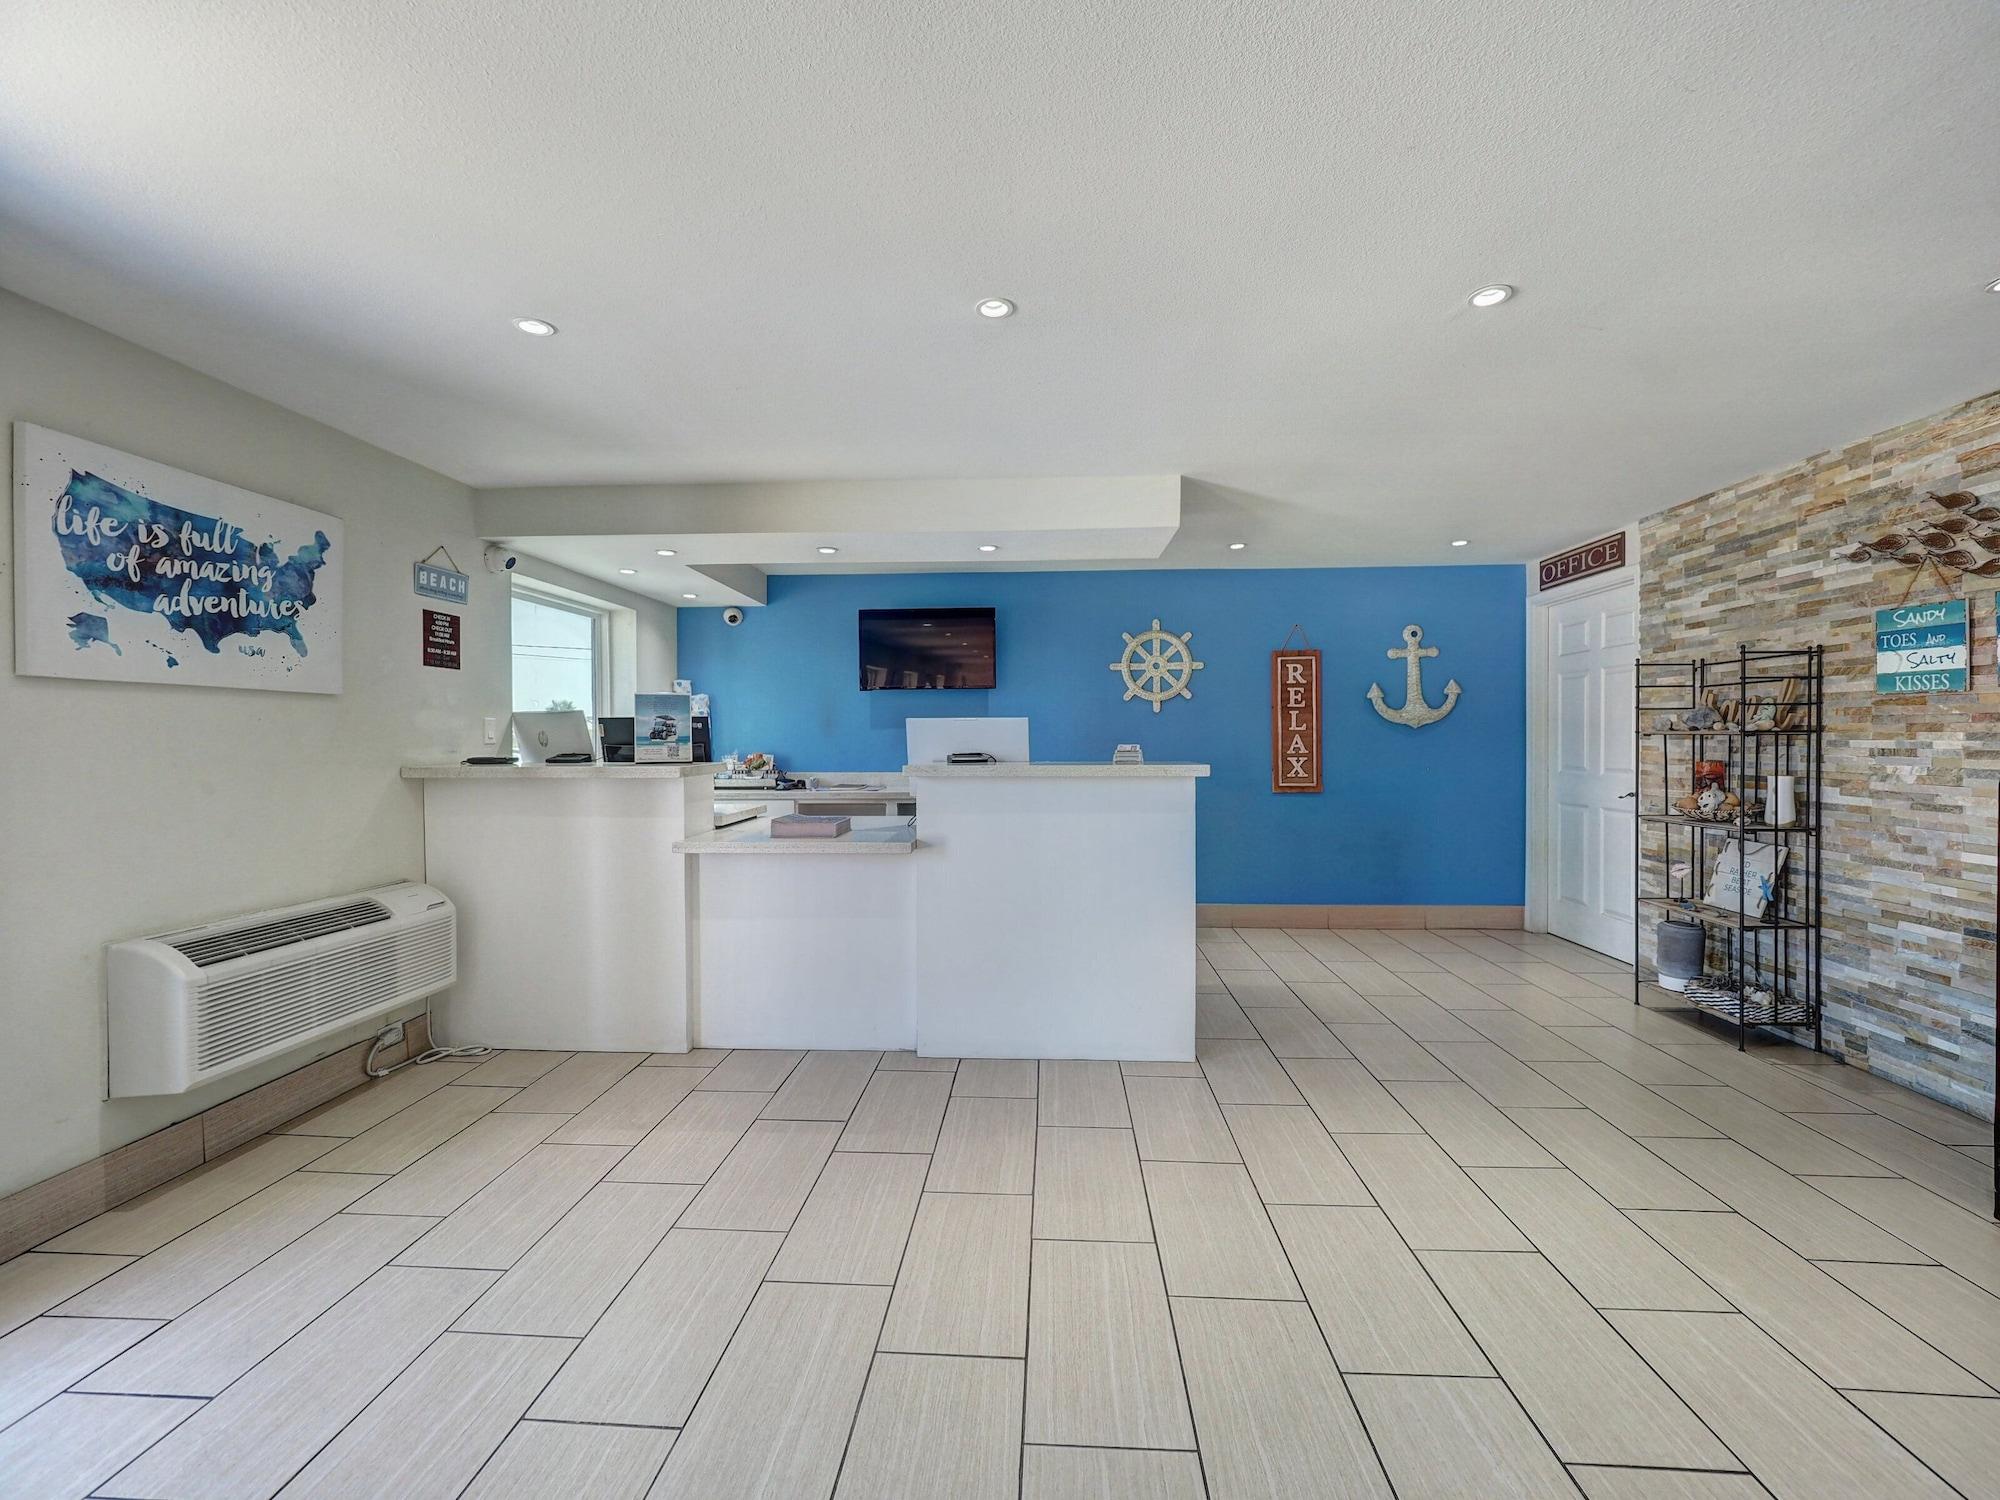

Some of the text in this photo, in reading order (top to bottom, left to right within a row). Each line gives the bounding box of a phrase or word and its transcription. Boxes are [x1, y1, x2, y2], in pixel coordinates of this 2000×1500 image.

[56, 495, 240, 556] life is full
[106, 545, 276, 593] of amazing
[1542, 541, 1619, 582] OFFICE
[420, 571, 465, 594] BEACH
[152, 579, 305, 620] adventures
[1893, 608, 1946, 627] SANDY
[1880, 632, 1916, 648] TOES
[1906, 652, 1956, 669] SALTY
[1895, 674, 1950, 691] KISSES
[1286, 664, 1309, 778] RELAX
[1730, 867, 1757, 878] RAHER
[1724, 884, 1752, 896] SEASDE
